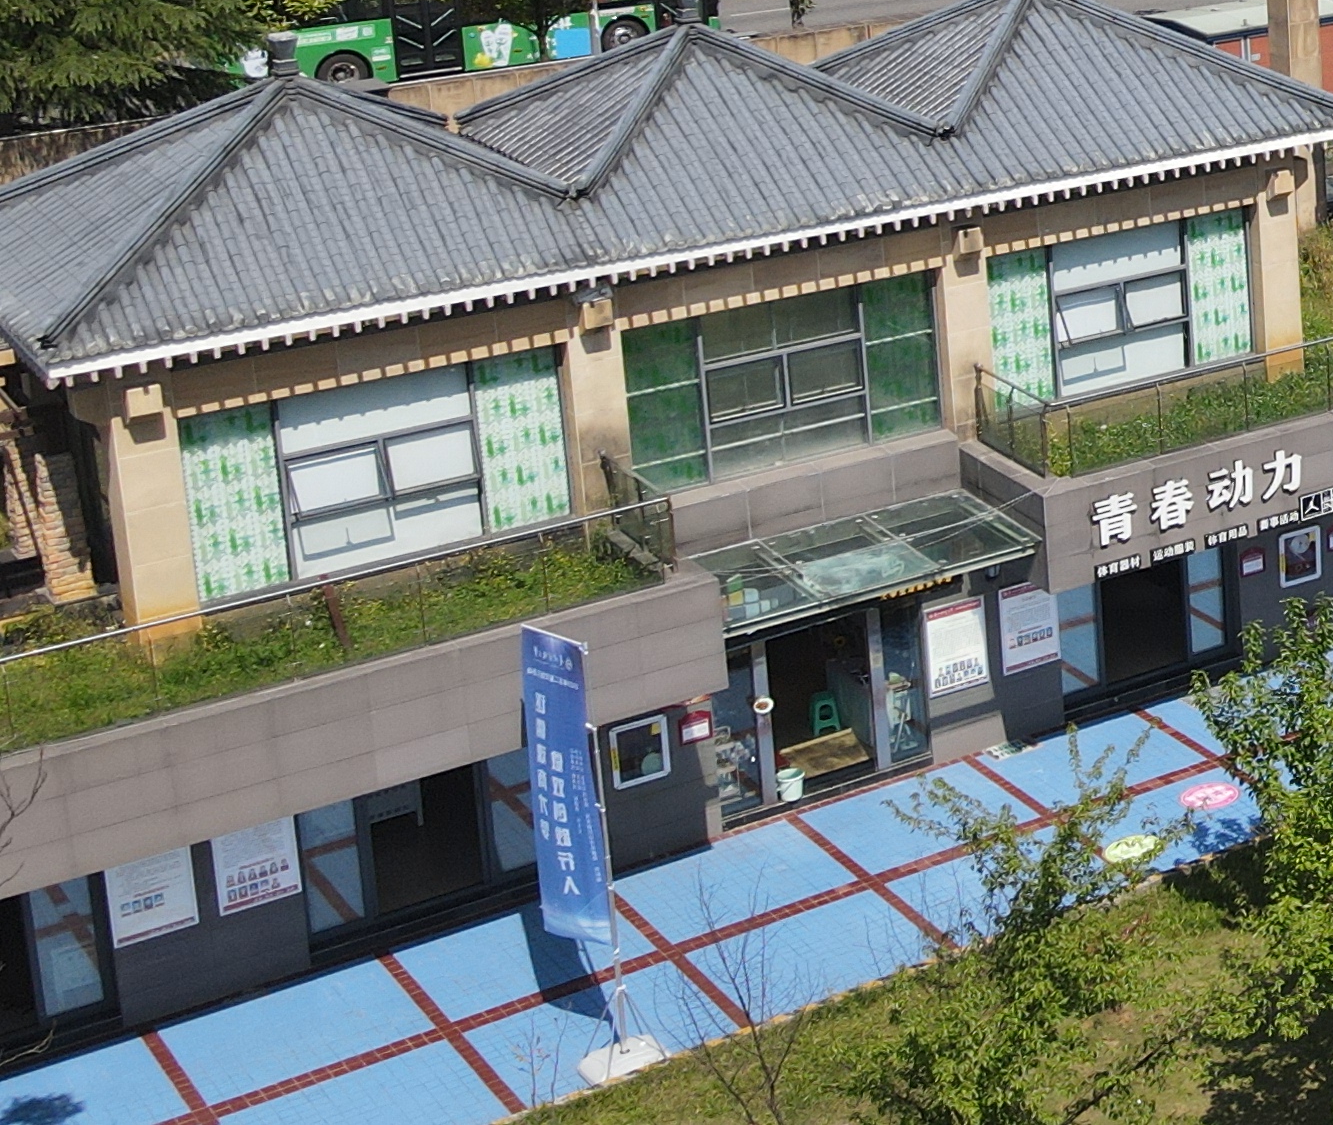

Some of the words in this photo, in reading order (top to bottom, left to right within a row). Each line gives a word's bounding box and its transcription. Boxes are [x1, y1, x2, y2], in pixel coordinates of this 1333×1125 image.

[1092, 449, 1302, 547] 青春动力
[1097, 555, 1141, 578] 体育器材
[1153, 540, 1195, 562] 运动服装
[1208, 524, 1248, 547] 体育用品
